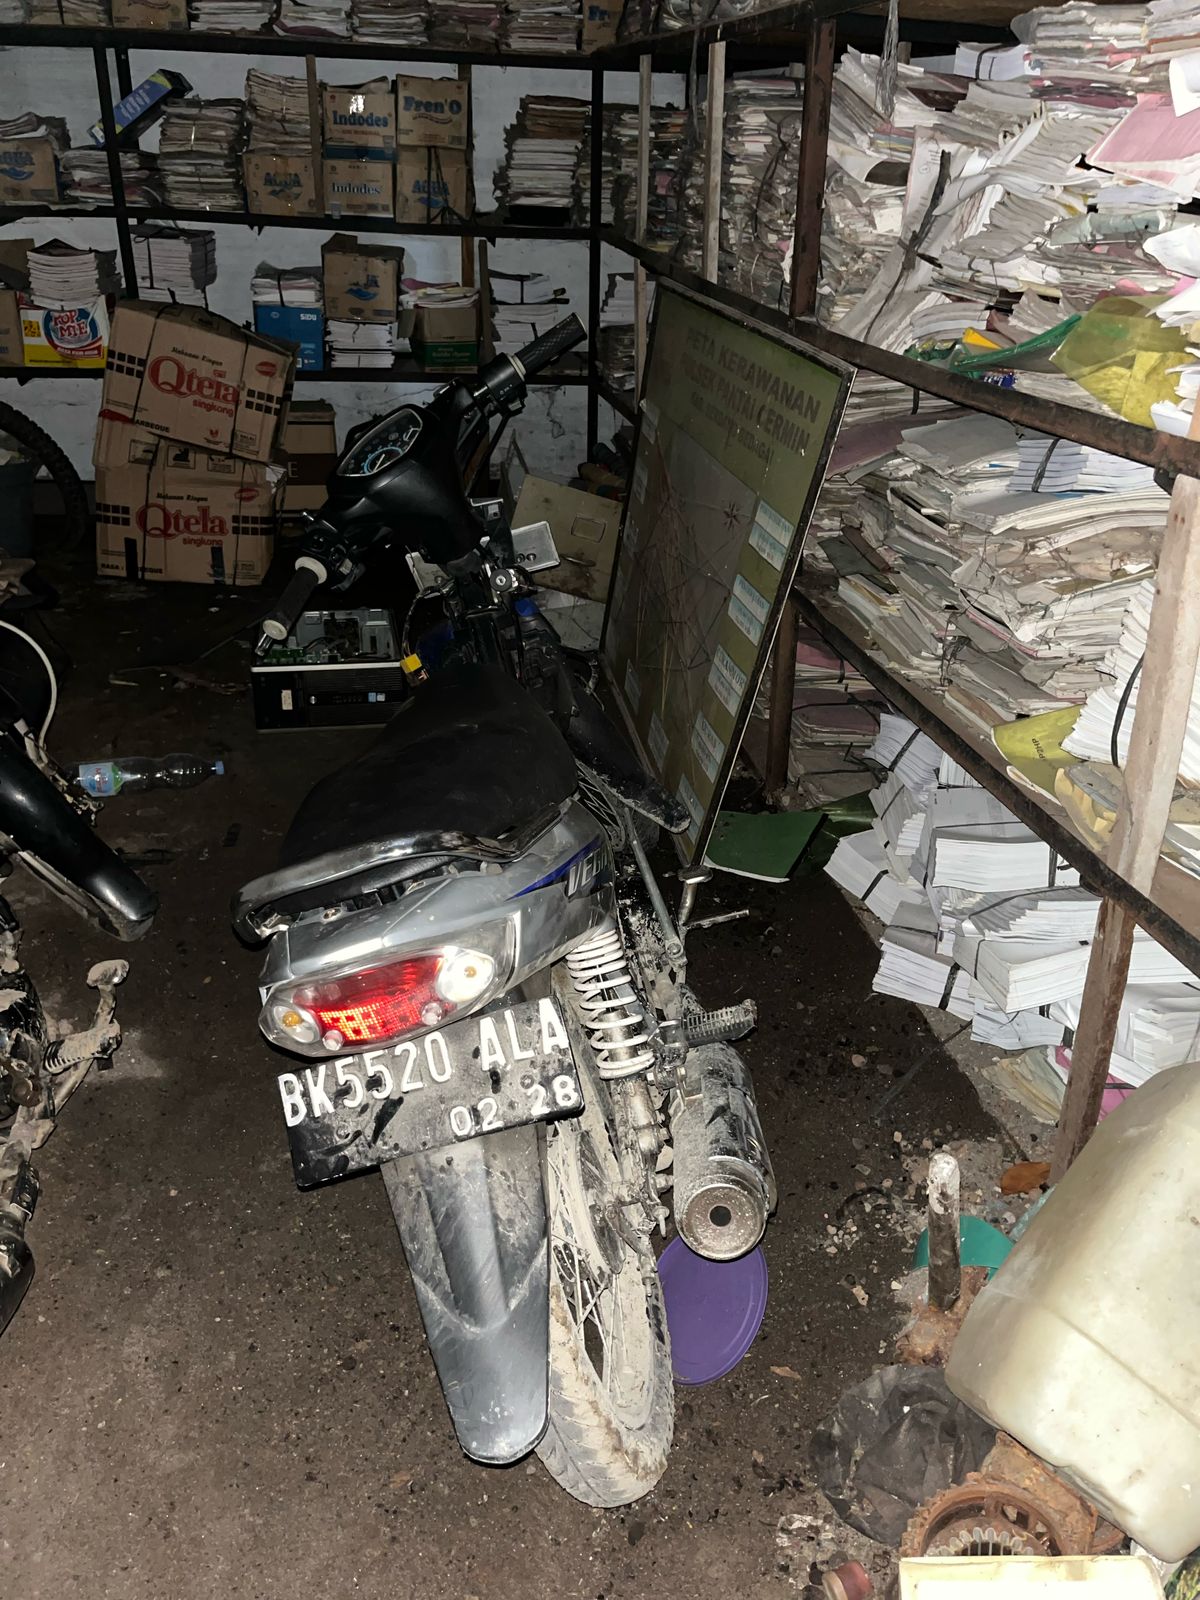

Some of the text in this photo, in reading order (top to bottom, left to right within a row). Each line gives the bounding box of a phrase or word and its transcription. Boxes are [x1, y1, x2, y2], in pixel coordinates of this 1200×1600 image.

[332, 111, 389, 127] Indodes
[331, 182, 381, 195] Indodes
[148, 355, 241, 405] Qtela
[718, 346, 821, 424] KERAWANAN
[135, 418, 170, 432] ARBEQUE
[758, 404, 810, 453] CERMIN
[136, 502, 229, 540] Qtela
[478, 997, 570, 1072] ALA
[449, 1074, 580, 1137] 02 28
